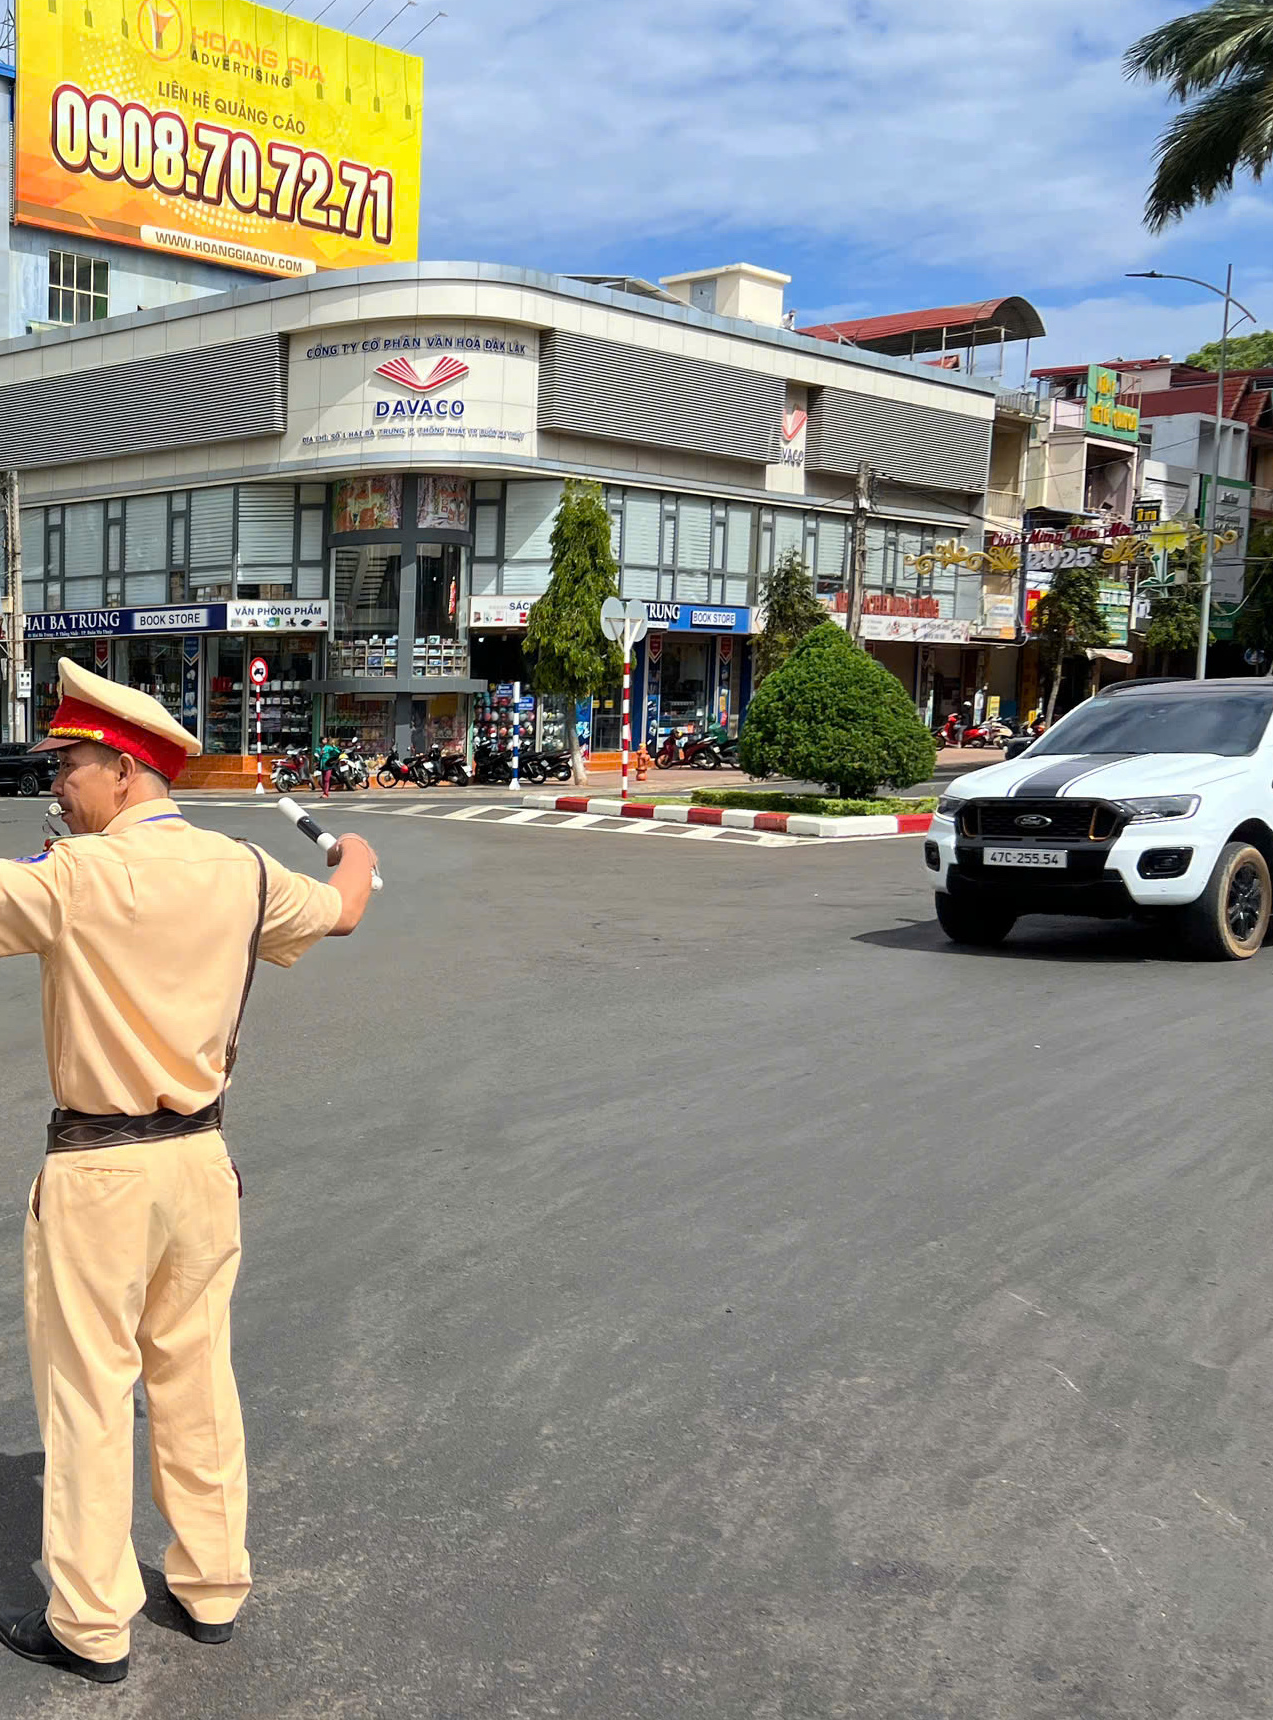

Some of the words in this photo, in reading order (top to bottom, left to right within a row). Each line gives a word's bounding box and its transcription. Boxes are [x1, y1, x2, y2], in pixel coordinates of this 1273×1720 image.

[191, 26, 278, 69] HOANG
[287, 57, 326, 83] GIA
[191, 50, 291, 89] ADVERTISING
[158, 80, 188, 102] LIÊN
[193, 91, 210, 114] HỆ
[215, 99, 268, 126] QUẢNG
[273, 113, 306, 135] CÁO
[51, 84, 393, 245] 0908.70.72.71
[155, 231, 303, 273] WWW.HOANGGIAADV.COM
[306, 344, 338, 359] CÔNG
[341, 343, 357, 354] TY
[427, 333, 453, 347] VĂN
[375, 400, 466, 417] DAVACO
[50, 615, 67, 630] BA
[68, 611, 121, 629] TRUNG
[140, 615, 166, 626] BOOK
[168, 613, 201, 625] STORE
[235, 606, 255, 616] VĂN
[257, 605, 291, 616] PHÒNG
[294, 603, 322, 616] PHẨM
[693, 612, 712, 623] BOOK
[713, 613, 735, 624] STORE
[990, 852, 1059, 865] 47C-255.54
